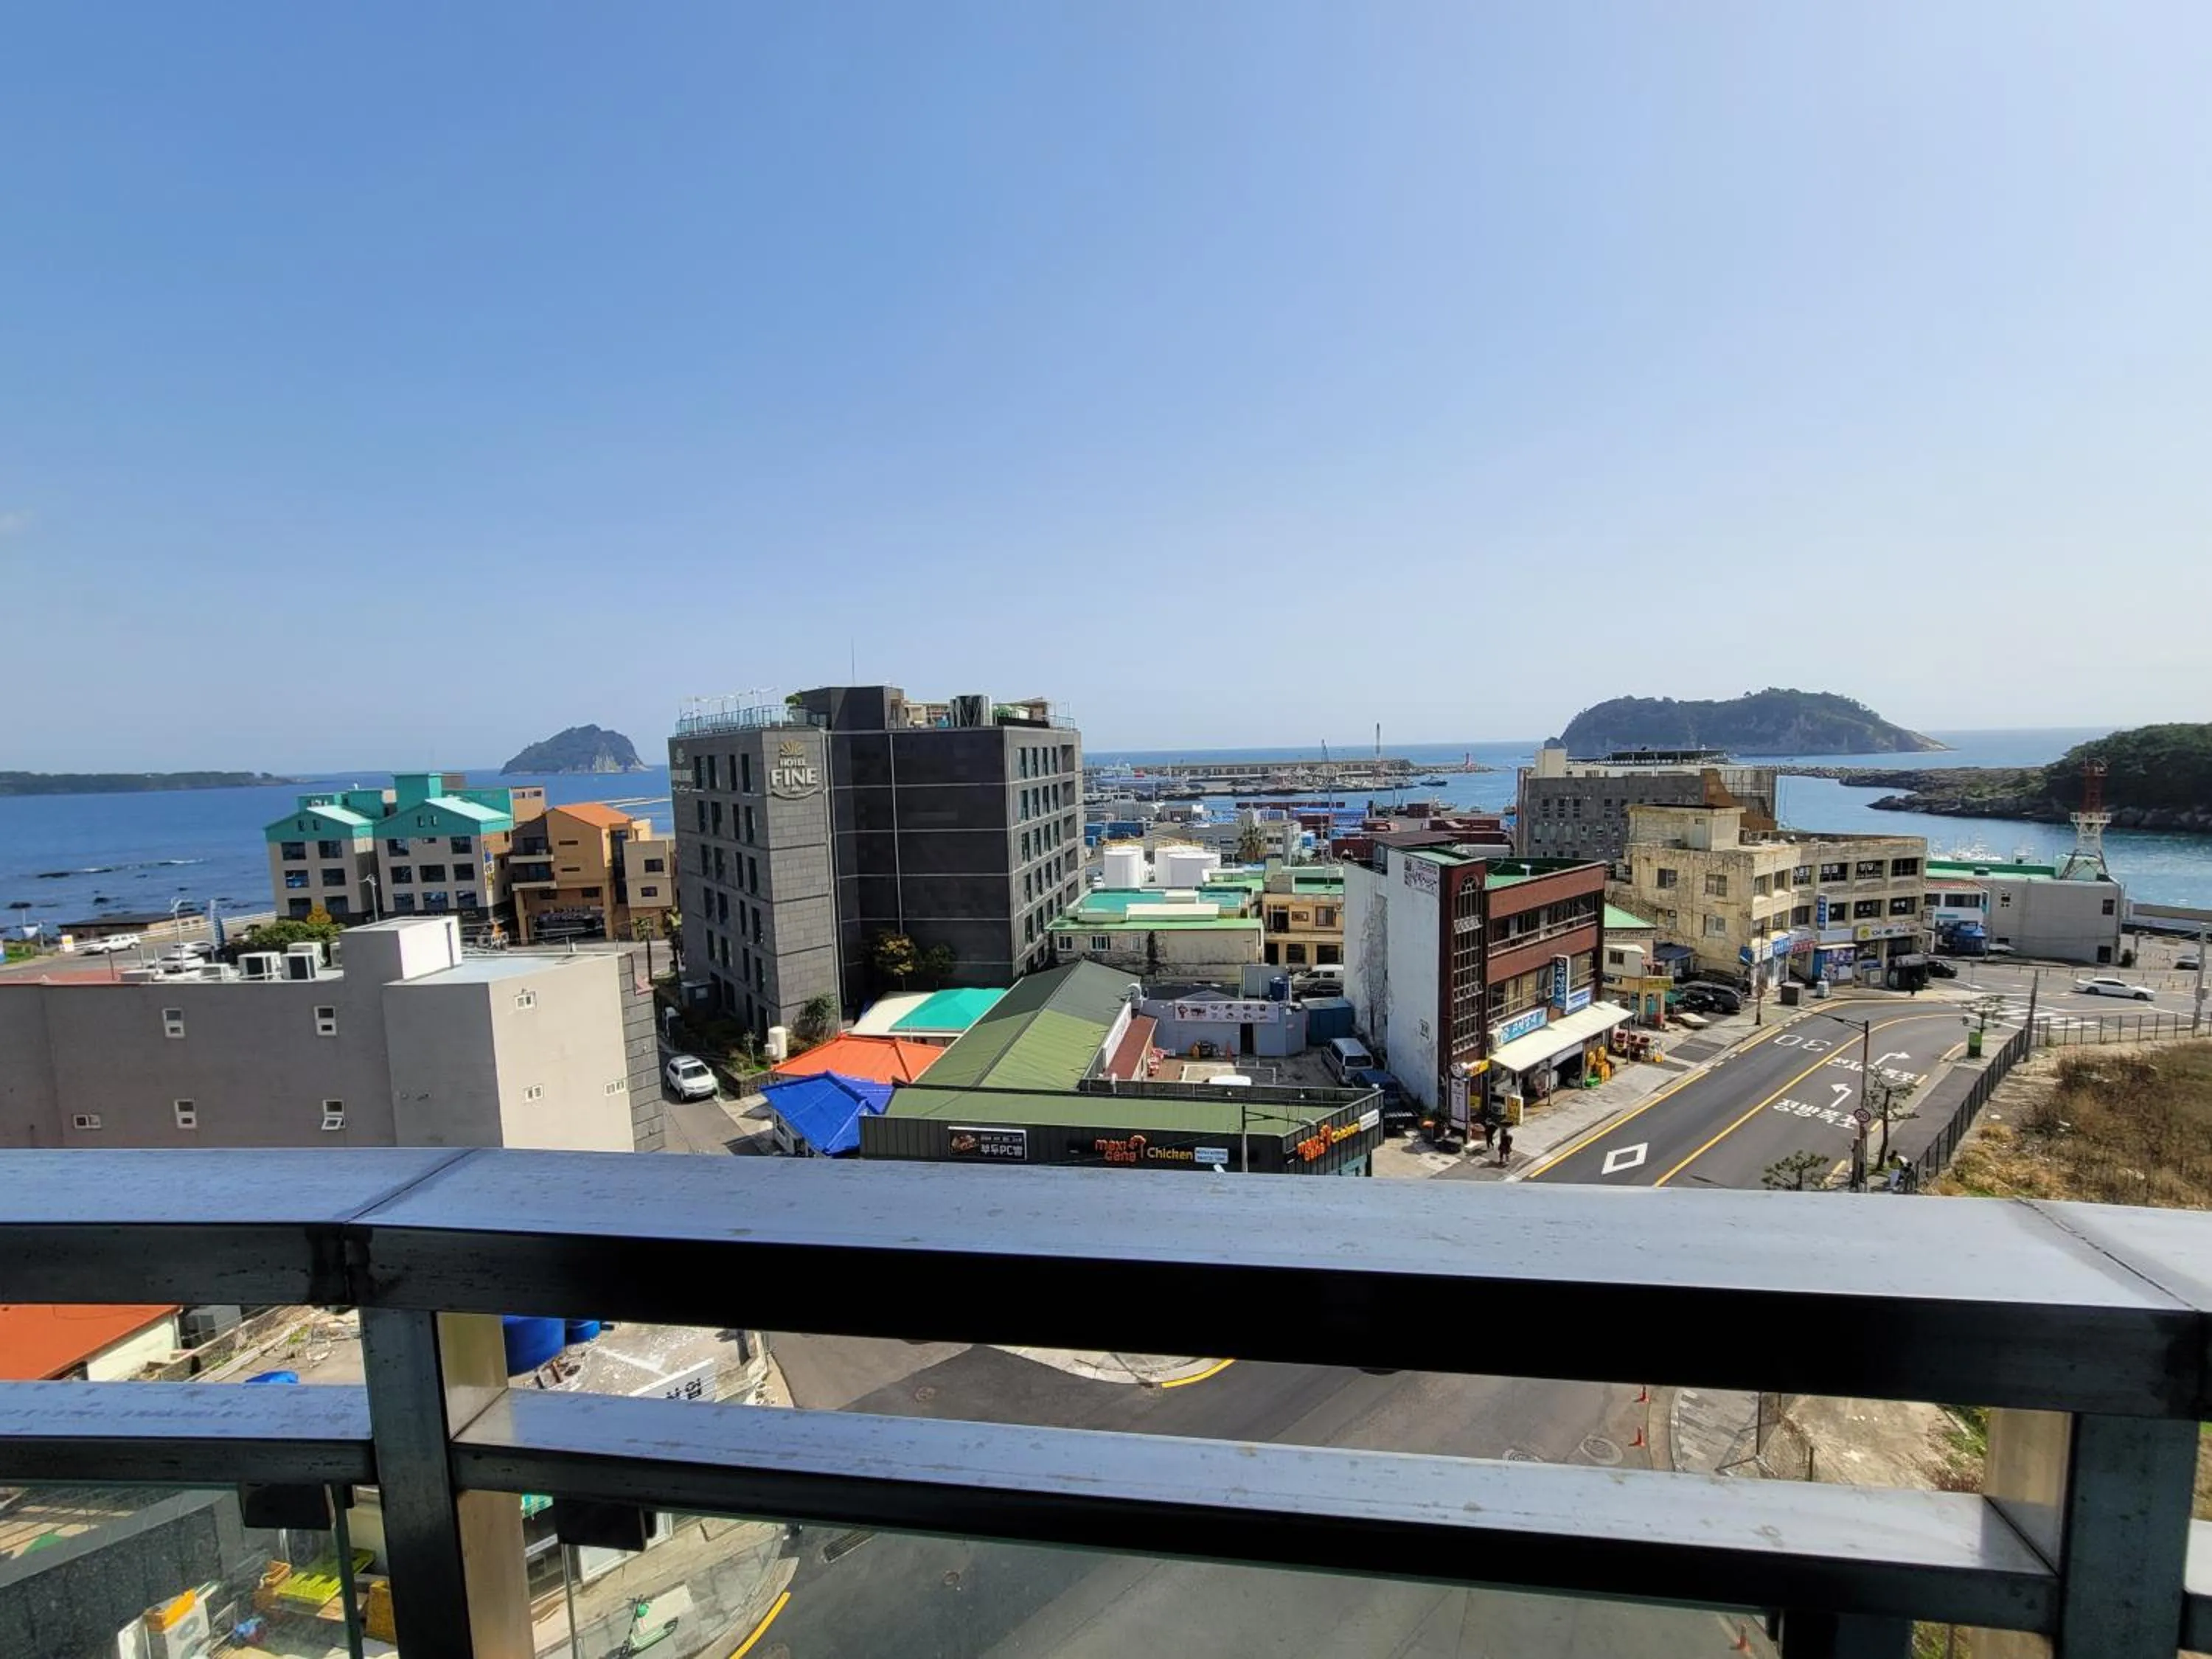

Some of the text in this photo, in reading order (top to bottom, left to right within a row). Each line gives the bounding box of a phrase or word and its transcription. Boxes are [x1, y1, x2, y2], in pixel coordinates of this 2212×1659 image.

[779, 757, 807, 768] HOTEL
[770, 768, 818, 787] FINE
[1147, 1147, 1193, 1161] Chicken
